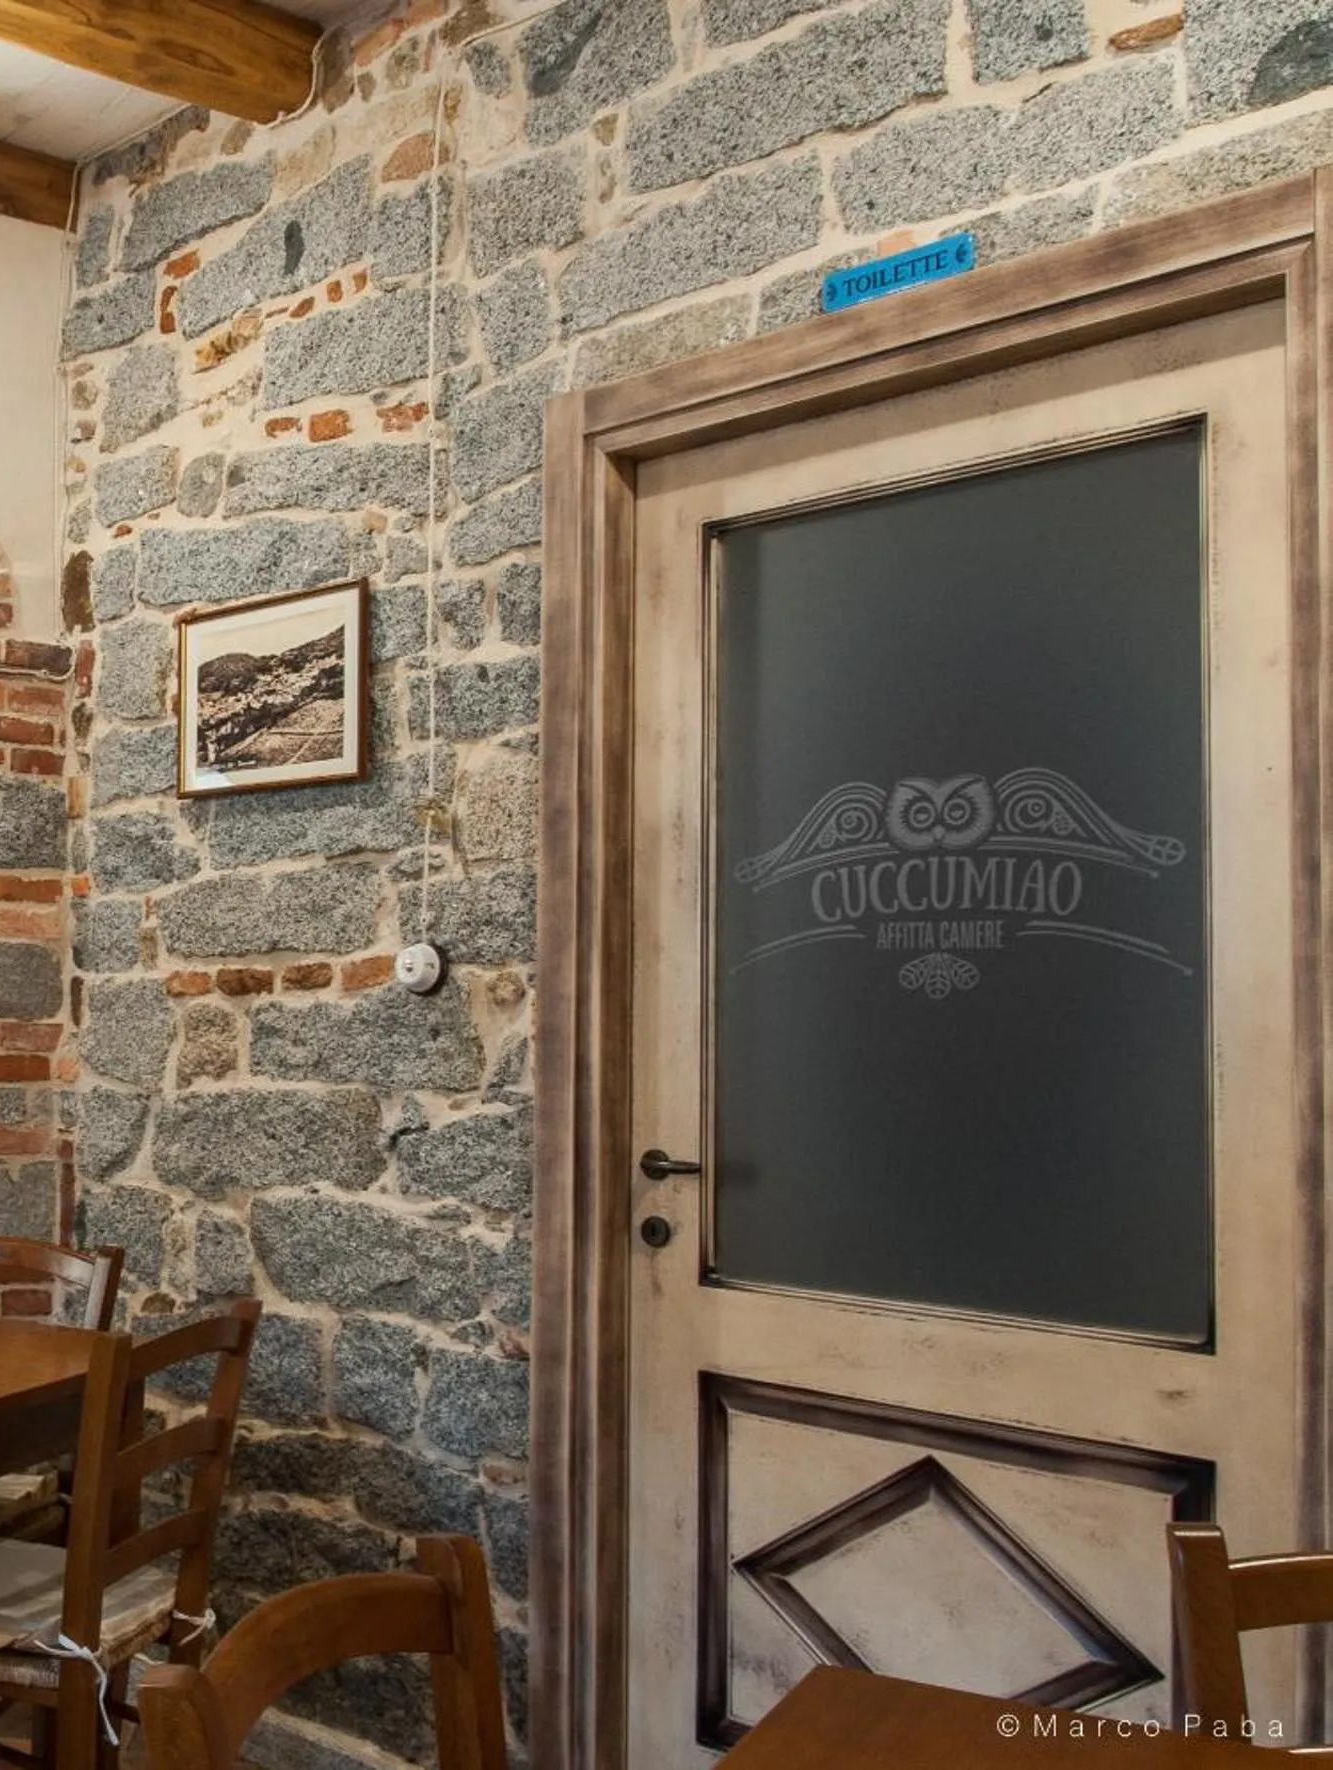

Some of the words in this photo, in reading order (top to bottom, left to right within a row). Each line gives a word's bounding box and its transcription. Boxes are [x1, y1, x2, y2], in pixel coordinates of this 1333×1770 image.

[843, 249, 948, 297] TOILETTE
[811, 856, 1083, 922] CUCCUMIAO
[876, 920, 935, 950] AFFITTA
[939, 920, 1006, 950] CAMERE
